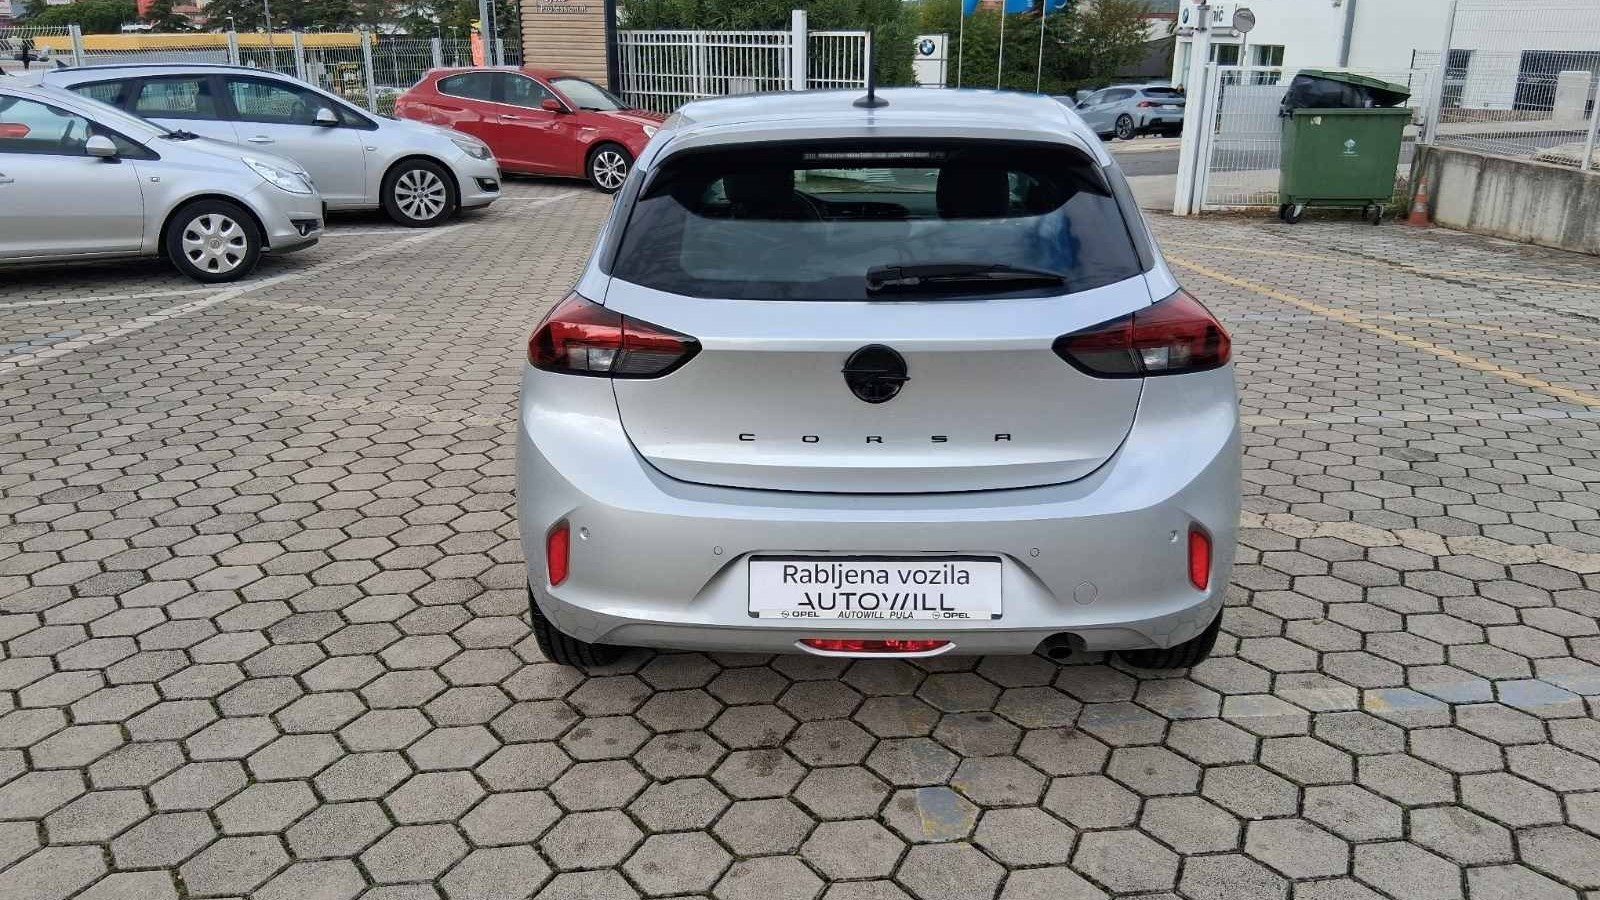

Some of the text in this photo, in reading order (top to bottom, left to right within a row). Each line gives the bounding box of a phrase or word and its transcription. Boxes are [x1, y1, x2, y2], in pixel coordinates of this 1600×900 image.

[738, 433, 1011, 444] CORSA
[783, 563, 970, 589] Rabljena vozila
[798, 592, 955, 611] AUTOWILL
[837, 611, 885, 619] AUTOWILL
[890, 611, 914, 619] PULA
